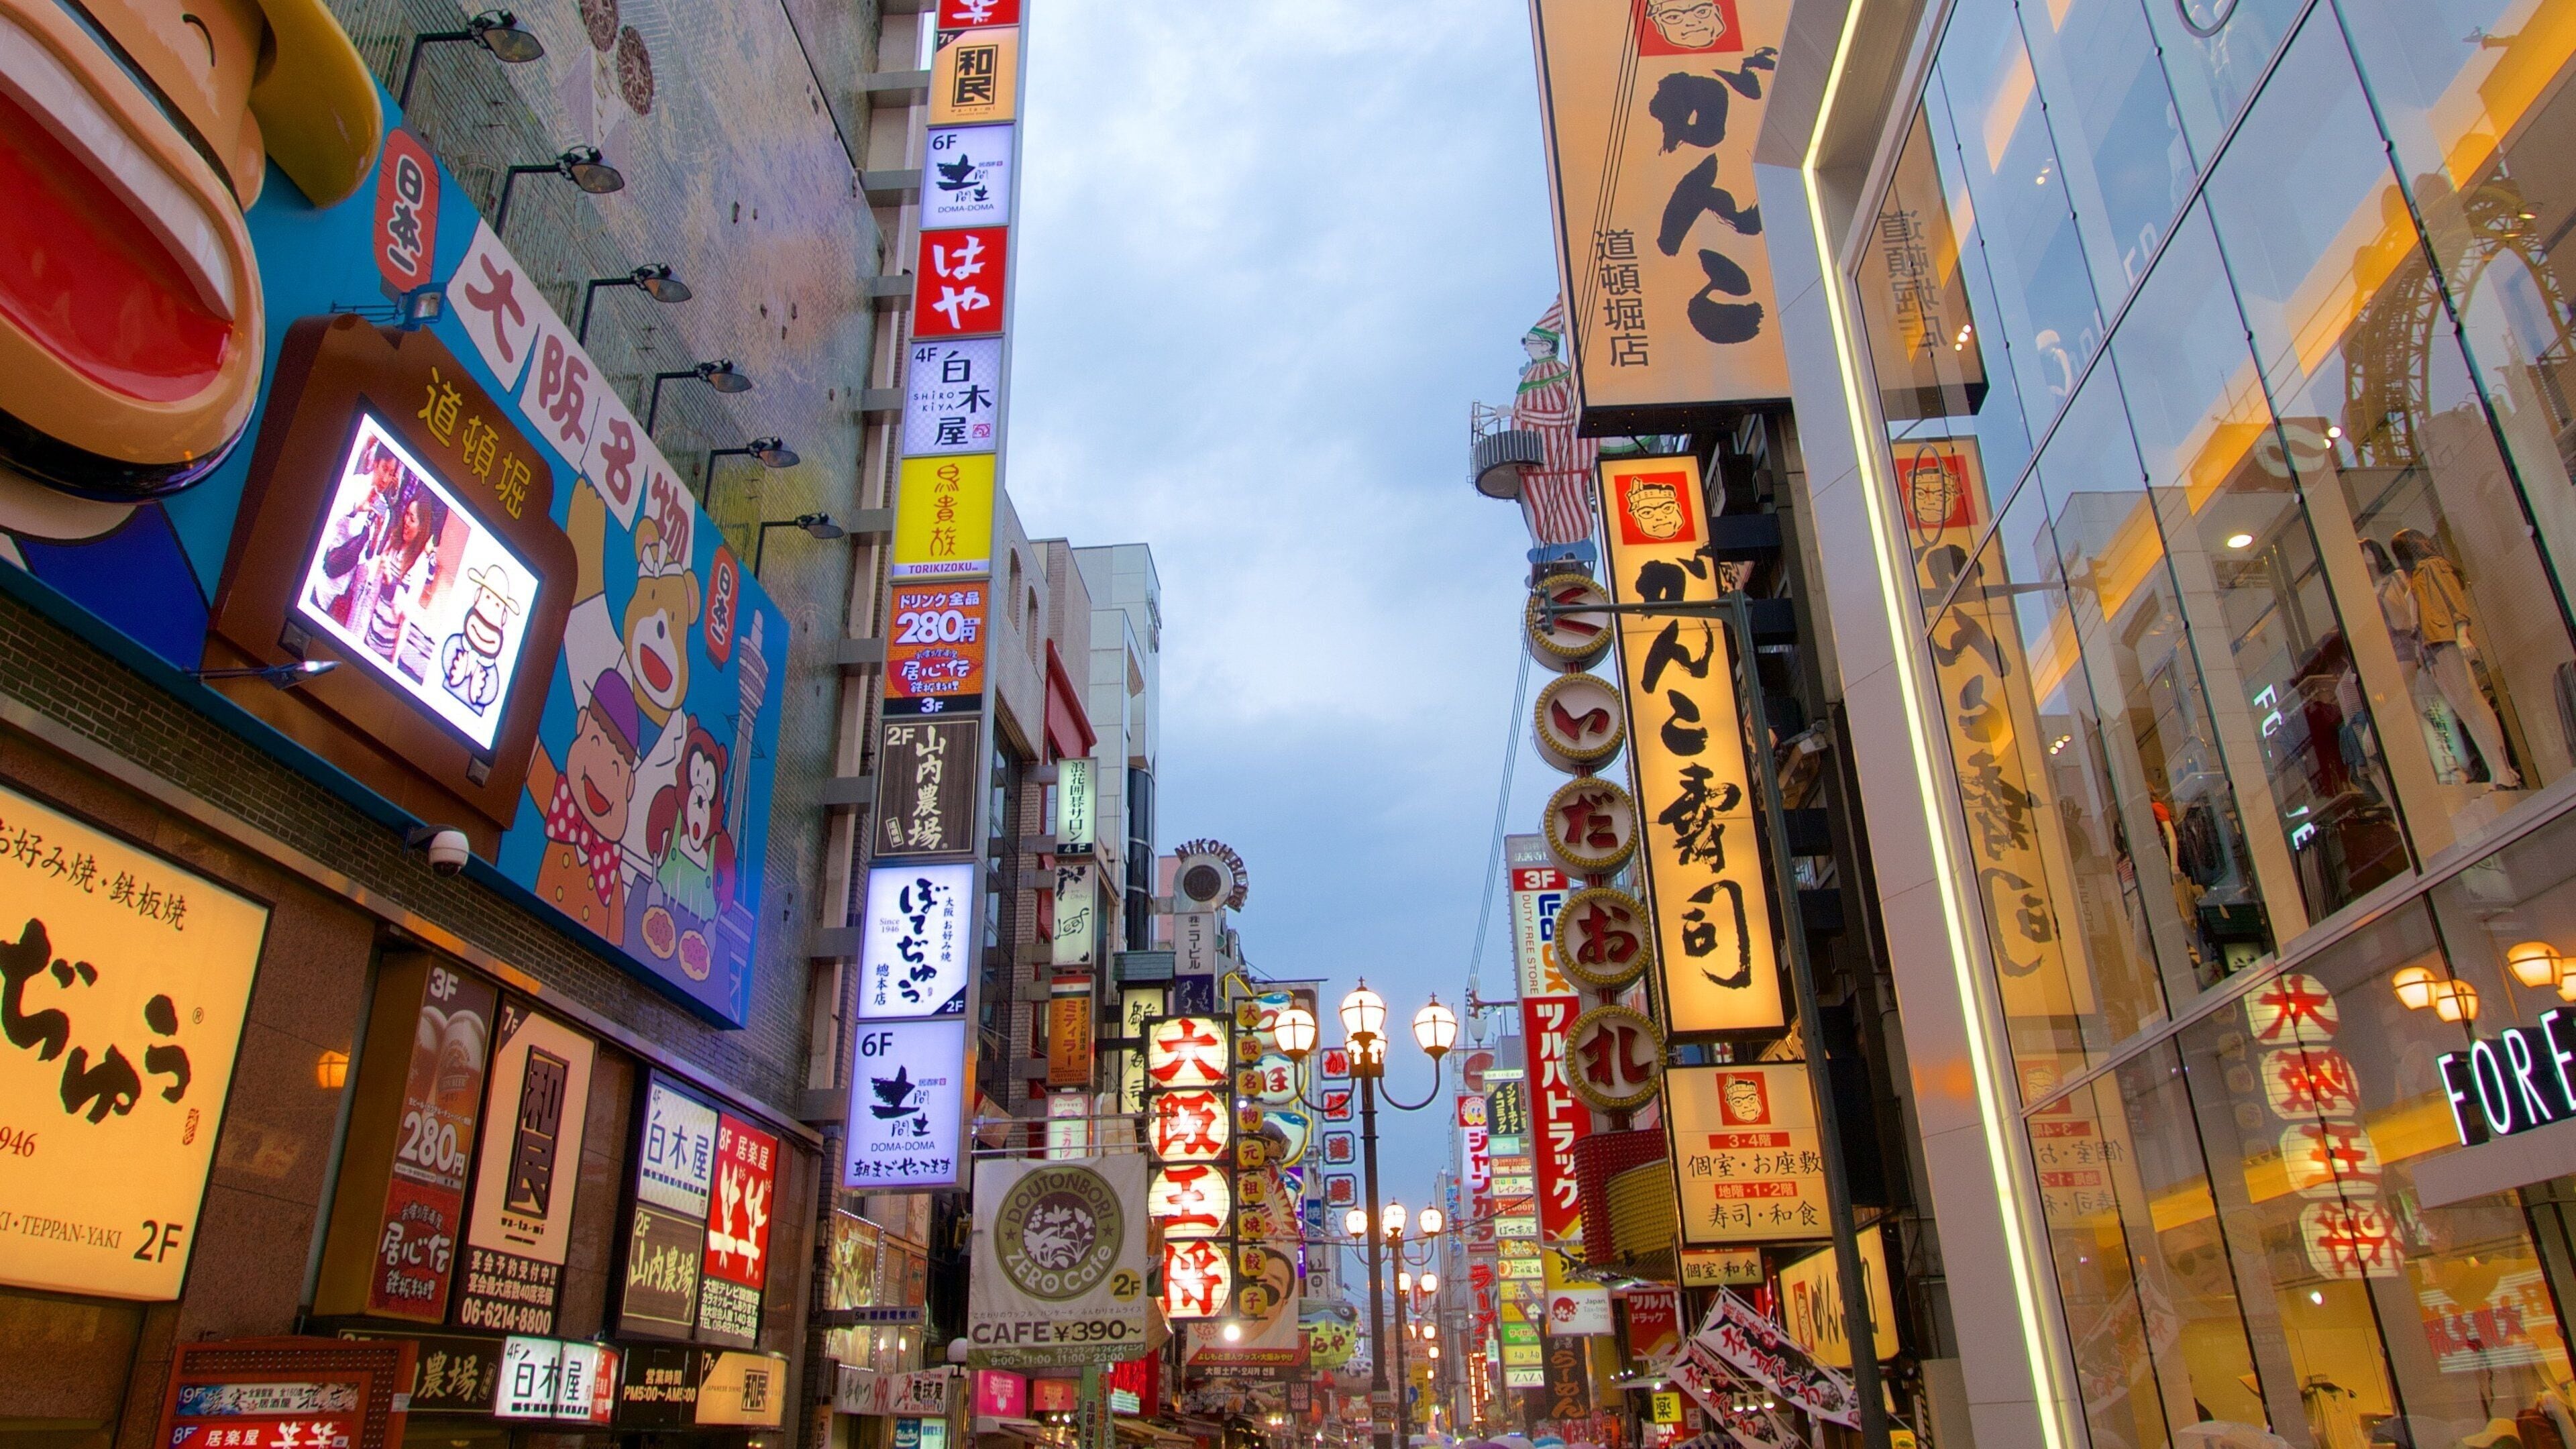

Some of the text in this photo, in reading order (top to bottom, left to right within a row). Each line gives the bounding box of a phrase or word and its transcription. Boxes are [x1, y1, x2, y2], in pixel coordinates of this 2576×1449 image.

[955, 48, 994, 104] 和民
[932, 135, 957, 150] 6F
[387, 153, 425, 277] 日本一
[938, 204, 995, 213] DOMA-DOMA
[1595, 228, 1650, 368] 道頓堀店
[916, 347, 938, 362] 4F
[934, 350, 993, 445] 白木屋
[417, 366, 531, 520] 道頓堀
[908, 562, 973, 574] TORIKIZOKU
[710, 561, 733, 645] 日本一
[900, 590, 980, 609] ドリンク 全品
[920, 697, 945, 713] 3F
[886, 727, 916, 746] 2F
[907, 724, 947, 851] 山内農場
[1523, 869, 1556, 889] 3F
[1522, 894, 1539, 995] DUTY FREE STORE
[430, 967, 460, 1001] 3F
[946, 1001, 964, 1013] 2F
[503, 1006, 520, 1034] 7F
[861, 1032, 894, 1058] 6F
[647, 1109, 709, 1181] 白木屋
[718, 1126, 733, 1152] 8F
[870, 1141, 935, 1152] DOMA-DOMA
[854, 1157, 951, 1177] 朝までやってます
[1006, 1172, 1114, 1225] DOUTONBORI
[635, 1212, 651, 1238] 2F
[133, 1220, 183, 1263] 2F
[629, 1239, 695, 1299] 山内農場
[1113, 1273, 1141, 1296] 2F
[1629, 1293, 1674, 1309] ツルハ
[461, 1297, 552, 1335] 06-6214-8800
[1631, 1312, 1668, 1324] ドラッグ
[971, 1320, 1051, 1344] CAFE
[506, 1342, 521, 1360] 4F
[704, 1352, 716, 1371] 7F
[645, 1368, 684, 1387] 営業時間
[1655, 1396, 1672, 1419] 薬
